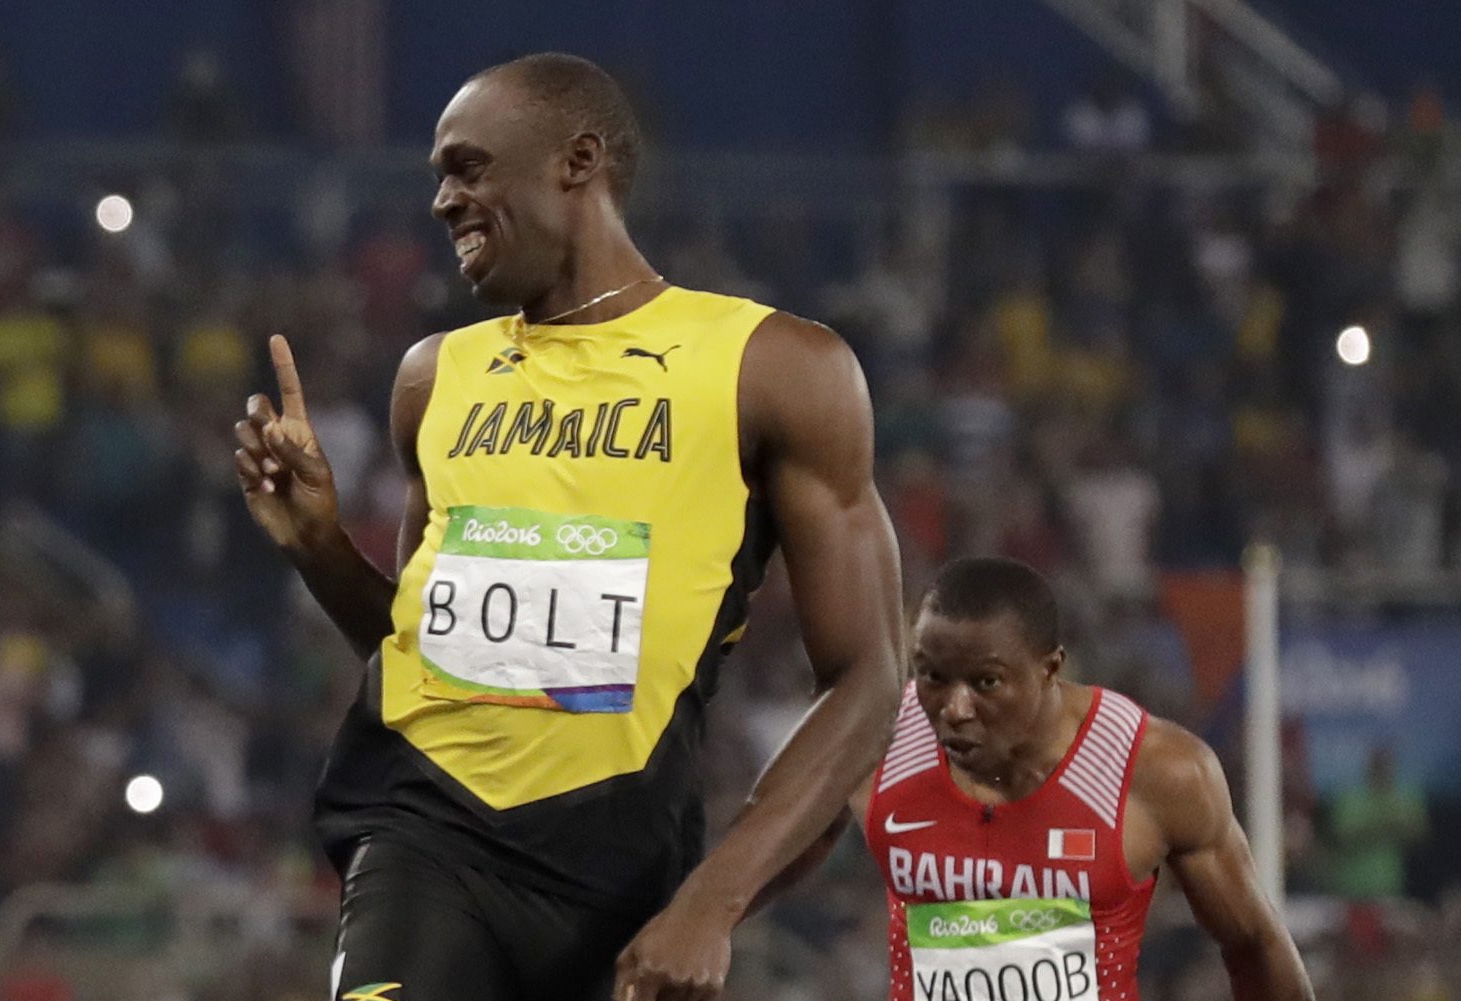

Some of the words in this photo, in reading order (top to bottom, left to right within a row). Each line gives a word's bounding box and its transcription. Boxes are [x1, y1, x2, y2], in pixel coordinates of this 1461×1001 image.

[448, 398, 671, 462] JAMAICA
[462, 518, 541, 546] Rio2016
[427, 580, 637, 653] BOLT
[890, 846, 1089, 900] BAHRAIN
[929, 915, 998, 937] Rio2016
